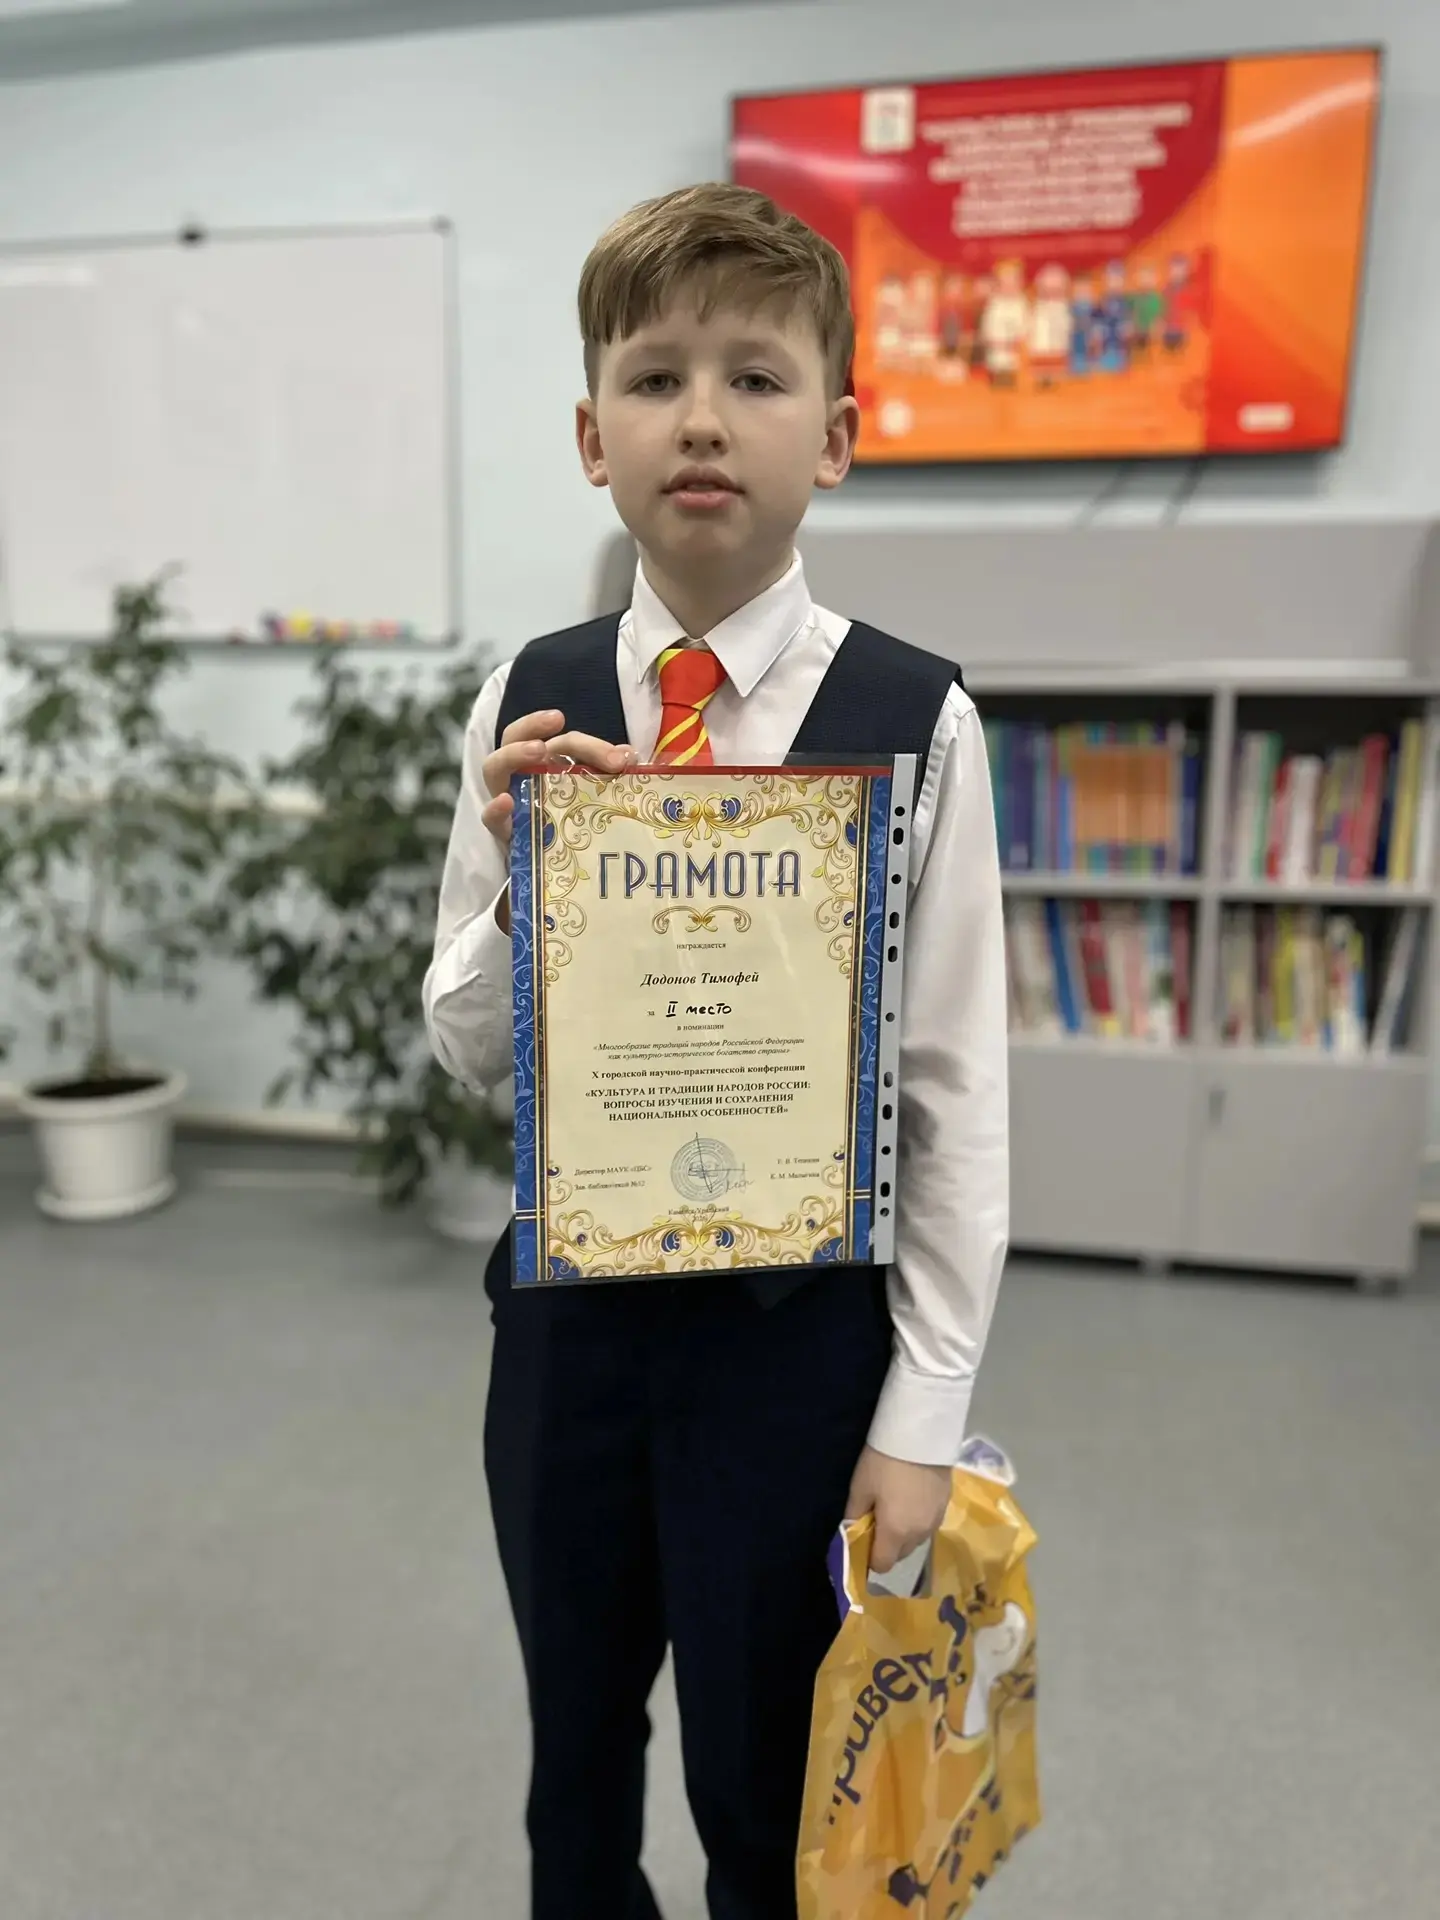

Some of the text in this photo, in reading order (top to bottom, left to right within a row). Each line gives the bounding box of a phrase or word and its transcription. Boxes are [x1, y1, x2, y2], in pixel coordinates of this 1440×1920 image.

[598, 849, 801, 899] ГРАМОТА
[676, 941, 727, 950] награждается
[640, 972, 760, 987] Додонов Тимофей
[686, 1002, 732, 1015] место
[653, 1041, 689, 1050] традиций
[690, 1040, 720, 1048] народов
[722, 1038, 763, 1047] Российской
[765, 1037, 805, 1046] Федерации
[623, 1051, 714, 1061] культурно-историческое
[601, 1069, 647, 1080] городской
[650, 1066, 745, 1078] научно-практической
[747, 1064, 805, 1075] конференции
[585, 1081, 811, 1098] «КУЛЬТУРА И ТРАДИЦИИ НАРОДОВ РОССИИ:
[603, 1100, 655, 1109] ВОПРОСЫ
[658, 1097, 713, 1107] ИЗУЧЕНИЯ
[725, 1094, 794, 1104] СОХРАНЕНИЯ
[609, 1105, 789, 1121] НАЦИОНАЛЬНЫХ ОСОБЕННОСТЕЙ»
